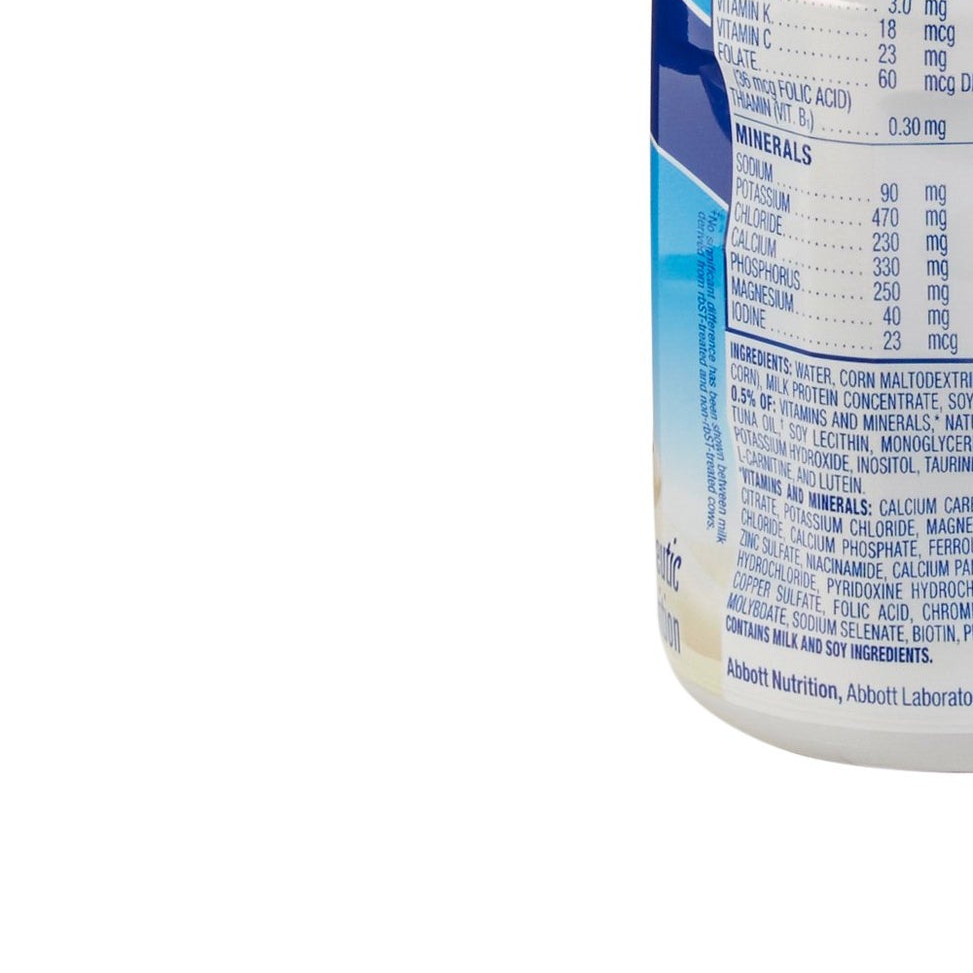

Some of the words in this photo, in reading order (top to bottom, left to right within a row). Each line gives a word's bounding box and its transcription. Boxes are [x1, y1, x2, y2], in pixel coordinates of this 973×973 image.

[763, 5, 771, 24] K
[880, 19, 896, 39] 18
[924, 24, 955, 46] mcg
[925, 0, 947, 21] mg
[718, 18, 760, 46] VITAMIN
[763, 29, 771, 49] C
[878, 44, 896, 64] 23
[924, 49, 947, 71] mg
[718, 42, 758, 71] FOLATE
[878, 69, 896, 89] 60
[925, 74, 955, 96] mcg
[735, 123, 812, 165] MINERALS
[736, 153, 773, 182] SODIUM
[880, 183, 898, 203] 90
[925, 184, 946, 206] mg
[736, 177, 790, 212] POTASSIUM
[872, 208, 899, 227] 470
[731, 227, 777, 258] CALCIUM
[873, 257, 900, 277] 330
[734, 202, 782, 235] CHLORIDE
[872, 232, 899, 252] 230
[731, 252, 800, 291] PHOSPHORUS
[873, 282, 901, 302] 250
[732, 278, 794, 313] MAGNESIUM
[883, 306, 901, 325] 40
[707, 301, 718, 362] difference
[732, 303, 766, 330] IODINE
[883, 331, 902, 351] 23
[928, 333, 958, 354] mcg
[730, 342, 792, 375] INGREDIENTS:
[795, 361, 835, 387] WATER,
[840, 369, 875, 388] CORN
[708, 390, 719, 420] been
[711, 423, 725, 461] shown
[717, 464, 728, 514] between
[716, 517, 728, 544] milk
[725, 615, 769, 643] CONTAINS
[773, 628, 798, 650] MILK
[800, 635, 822, 654] AND
[826, 641, 847, 658] SOY
[851, 643, 933, 664] INGREDIENTS.
[912, 625, 960, 645] BIOTIN,
[727, 657, 768, 683] Abbott
[772, 669, 843, 704] Nutrition,
[846, 683, 898, 707] Abbott
